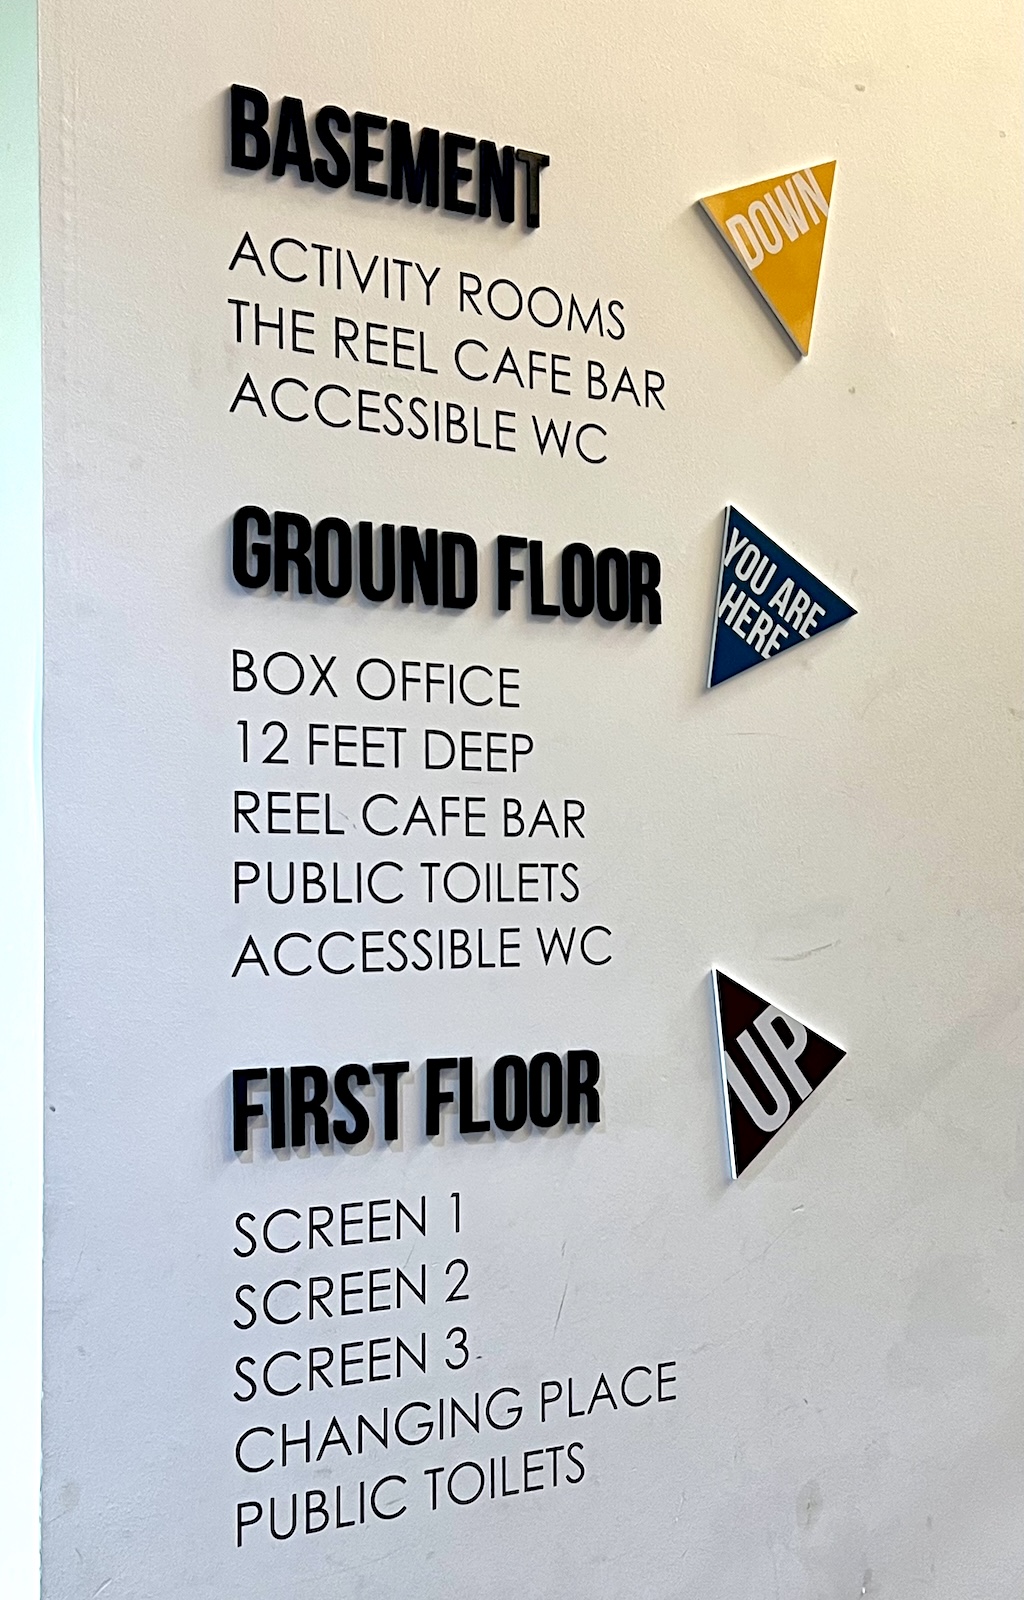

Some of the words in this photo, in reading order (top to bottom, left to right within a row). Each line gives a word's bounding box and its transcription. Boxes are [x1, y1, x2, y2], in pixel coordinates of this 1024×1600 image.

[230, 83, 550, 231] BASEMENT
[725, 168, 830, 271] DOWN
[228, 231, 441, 306] ACTIVITY
[459, 271, 625, 341] ROOMS
[228, 298, 315, 355] THE
[334, 316, 439, 375] REEL
[454, 339, 571, 396] CAFE
[587, 360, 666, 411] BAR
[229, 372, 516, 453] ACCESSIBLE
[531, 415, 607, 464] WC
[232, 505, 478, 611] GROUND
[496, 534, 662, 627] FLOOR
[723, 526, 778, 595] YOU
[767, 577, 827, 640] ARE
[718, 582, 789, 660] HERE
[232, 648, 338, 698] BOX
[356, 658, 520, 708] OFFICE
[236, 720, 289, 765] 12
[309, 723, 407, 769] FEET
[425, 729, 534, 773] DEEP
[234, 790, 345, 835] REEL
[362, 793, 486, 837] CAFE
[503, 798, 586, 839] BAR
[234, 861, 404, 905] PUBLIC
[420, 861, 580, 904] TOILETS
[231, 927, 521, 978] ACCESSIBLE
[536, 925, 612, 966] WC
[232, 1060, 410, 1153] FIRST
[425, 1049, 601, 1137] FLOOR
[724, 1004, 813, 1132] UP
[233, 1195, 426, 1258] SCREEN
[450, 1192, 460, 1233] 1
[233, 1263, 426, 1330] SCREEN
[445, 1258, 469, 1303] 2
[233, 1332, 426, 1402] SCREEN
[445, 1326, 469, 1370] 3
[235, 1387, 523, 1473] CHANGING
[541, 1361, 677, 1423] PLACE
[237, 1474, 407, 1548] PUBLIC
[423, 1441, 586, 1511] TOILETS
